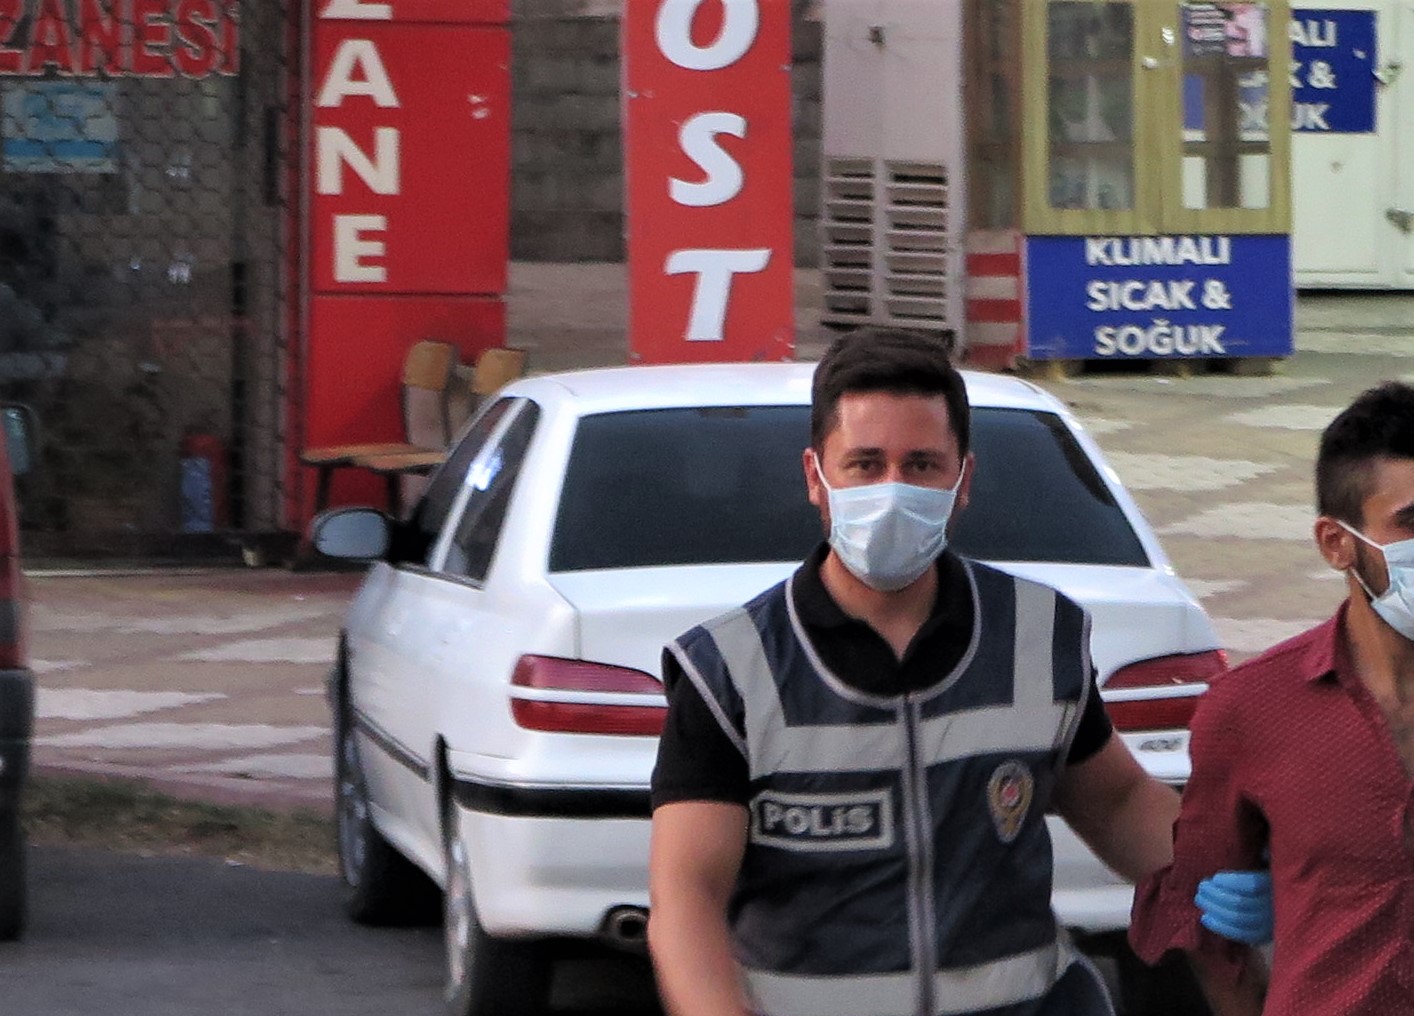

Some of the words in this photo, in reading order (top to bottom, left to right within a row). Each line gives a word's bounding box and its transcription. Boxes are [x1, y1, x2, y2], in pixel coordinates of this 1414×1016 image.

[316, 0, 400, 283] ANE
[1085, 278, 1197, 311] SICAK
[1201, 278, 1233, 310] &
[1093, 317, 1226, 356] SOĞUK
